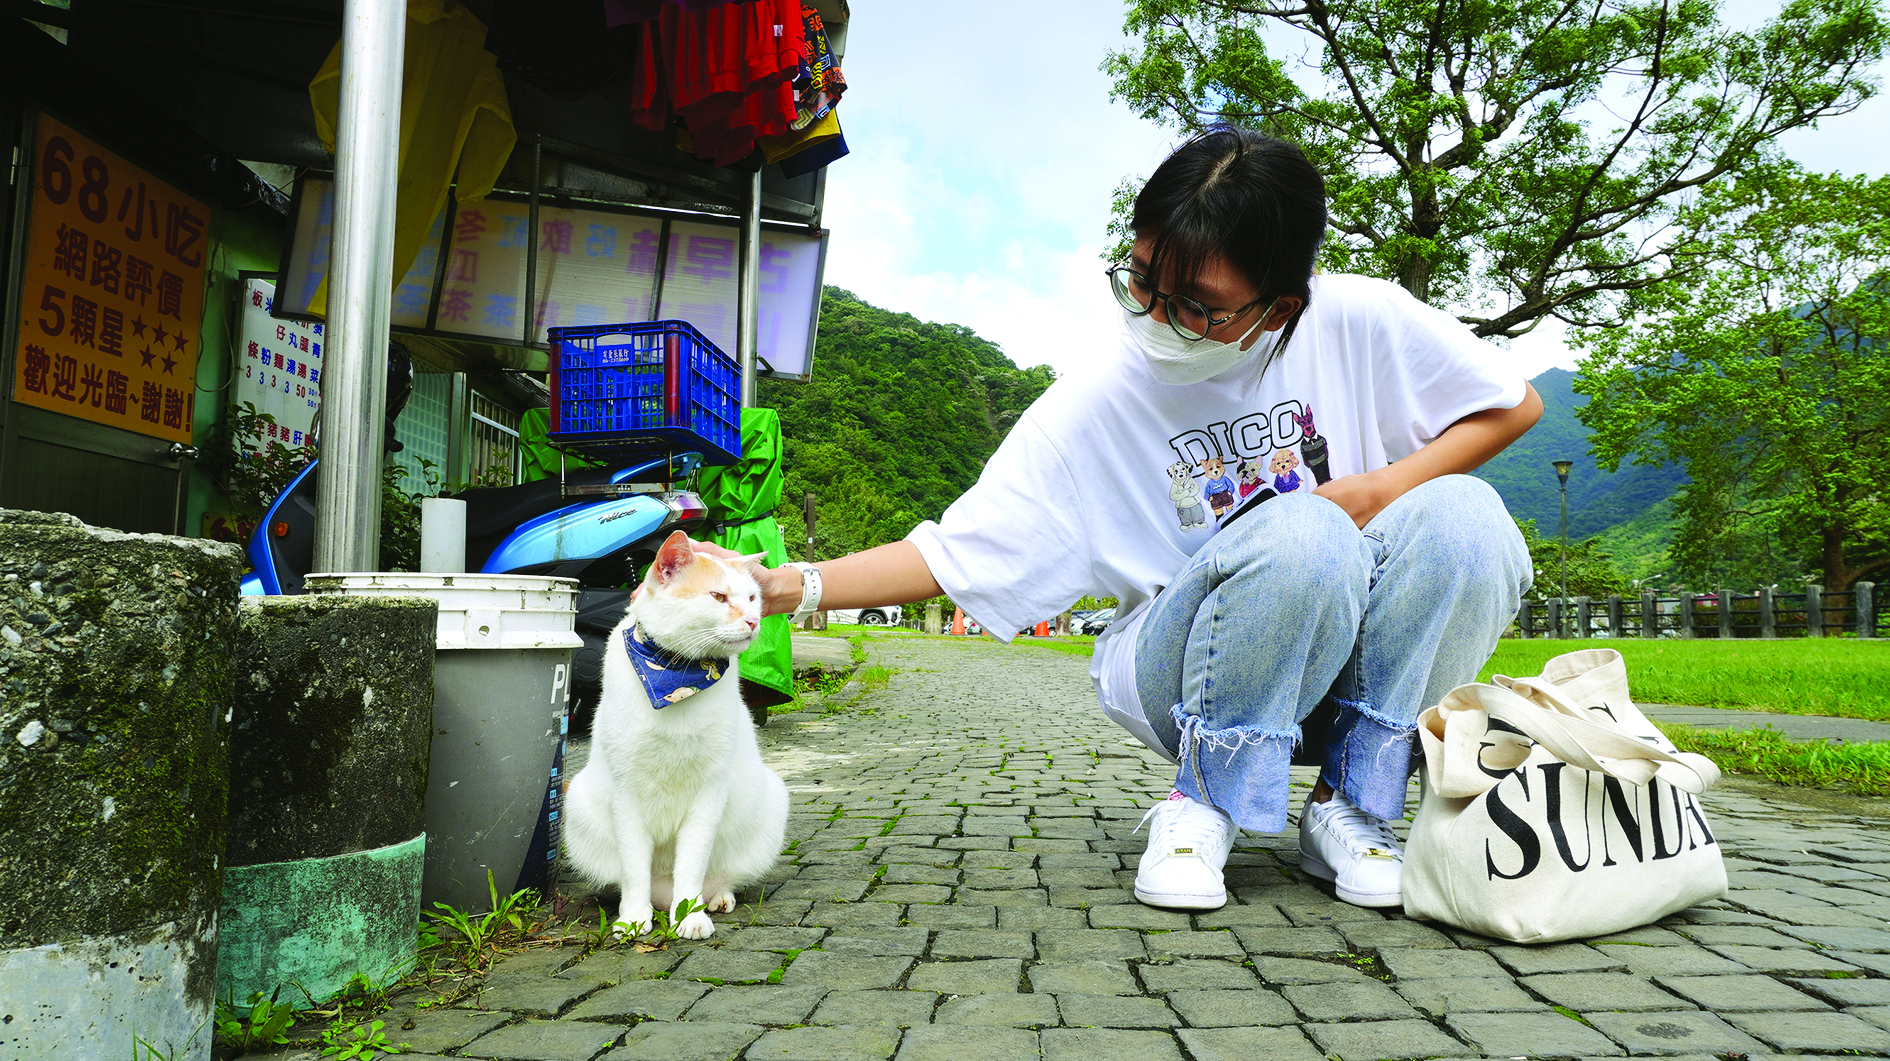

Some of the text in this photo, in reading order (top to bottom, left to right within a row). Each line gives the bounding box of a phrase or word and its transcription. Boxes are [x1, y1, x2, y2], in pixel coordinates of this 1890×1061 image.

[42, 136, 205, 268] 68小吃
[53, 222, 184, 321] 網路評價
[38, 284, 124, 358] 5顆星
[296, 384, 306, 398] 50
[1169, 400, 1304, 478] DICO
